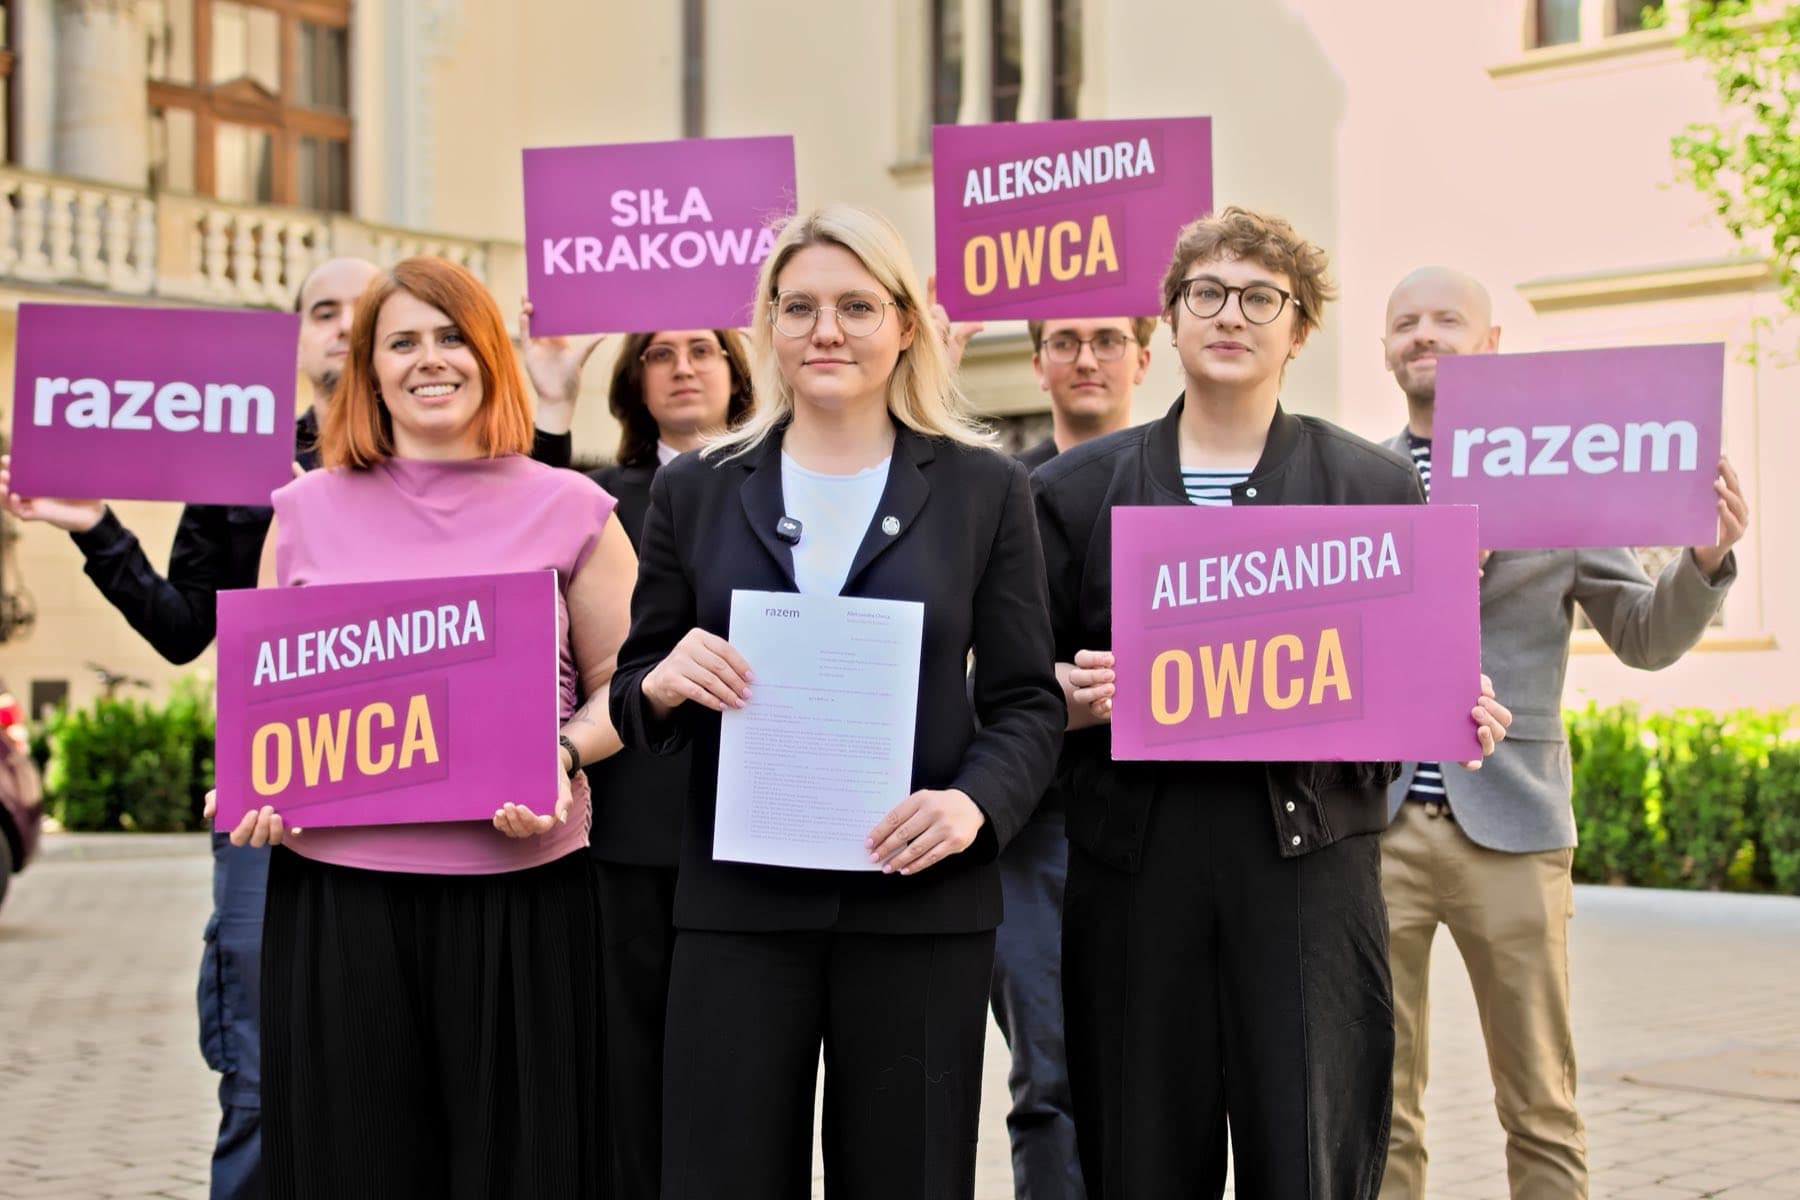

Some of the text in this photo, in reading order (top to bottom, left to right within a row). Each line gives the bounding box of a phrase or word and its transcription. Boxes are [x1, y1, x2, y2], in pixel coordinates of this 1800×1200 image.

[610, 186, 713, 227] SIŁA
[963, 137, 1156, 208] ALEKSANDRA
[543, 227, 777, 275] KRAKOWA
[963, 214, 1119, 296] OWCA
[33, 376, 276, 435] razem
[1451, 420, 1698, 478] razem
[1151, 531, 1402, 611] ALEKSANDRA
[253, 599, 486, 687] ALEKSANDRA
[765, 607, 800, 619] razem
[1150, 627, 1353, 726] OWCA
[251, 694, 440, 796] OWCA
